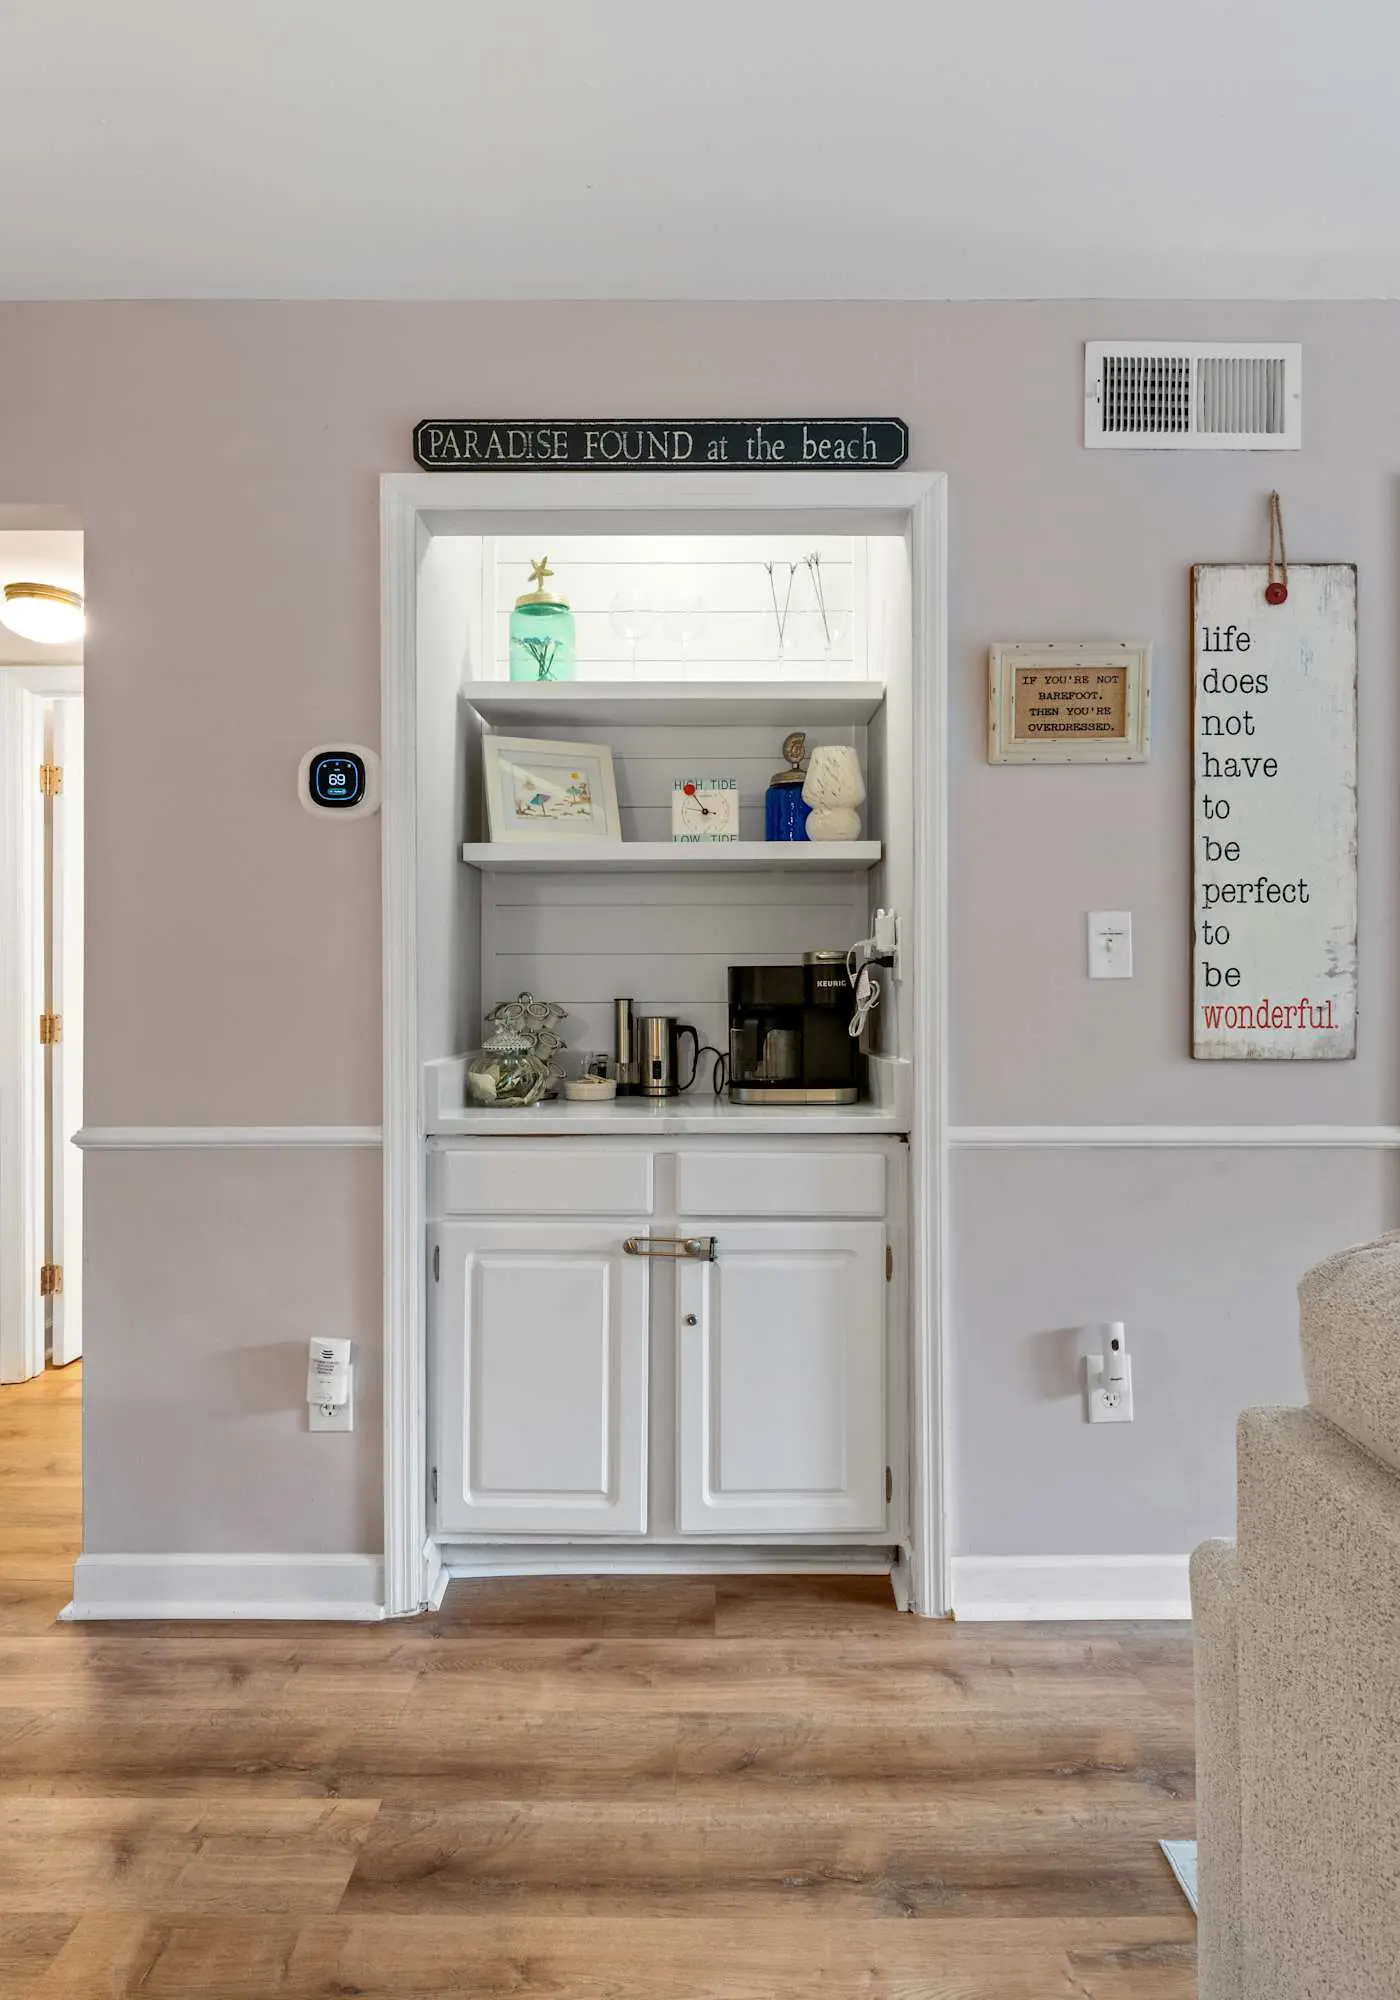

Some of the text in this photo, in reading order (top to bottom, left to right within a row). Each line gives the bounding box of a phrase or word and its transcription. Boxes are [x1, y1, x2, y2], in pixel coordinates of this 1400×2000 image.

[427, 426, 878, 461] PARADISE FOUND at the beach
[1202, 625, 1251, 652] life
[1022, 675, 1120, 685] IF YOU'RE NOT
[1202, 668, 1269, 694] does
[1029, 707, 1112, 717] THEN YOU'RE
[1201, 711, 1256, 736] not
[1027, 723, 1115, 732] OVERDRESSED.
[1201, 752, 1278, 778] have
[328, 773, 346, 786] 69
[710, 779, 737, 790] TIDE
[1202, 794, 1230, 820] to
[1201, 836, 1241, 862] be
[1202, 876, 1310, 909] perfect
[1202, 920, 1230, 945] to
[816, 979, 847, 987] KEURIG
[1201, 961, 1241, 987] be
[1201, 998, 1339, 1029] wonderful.
